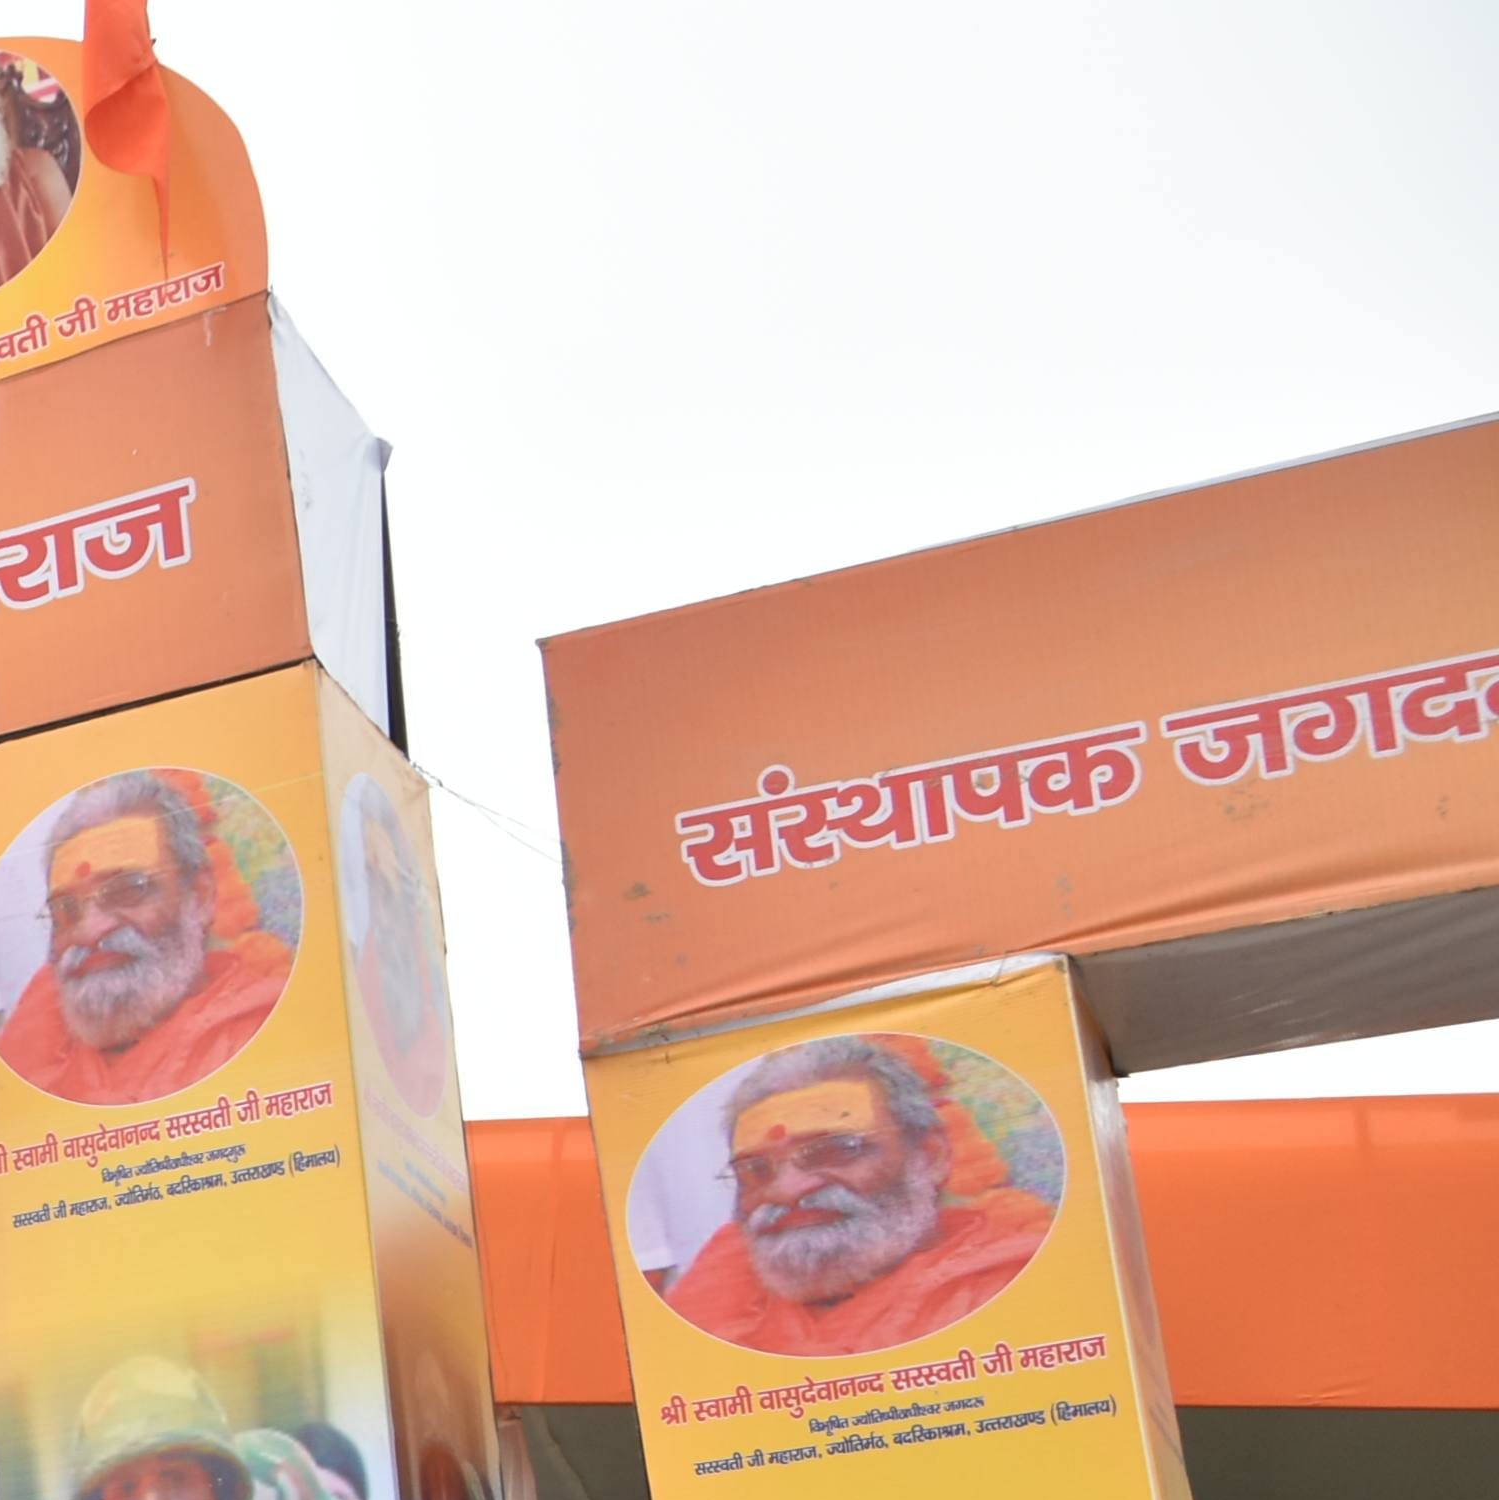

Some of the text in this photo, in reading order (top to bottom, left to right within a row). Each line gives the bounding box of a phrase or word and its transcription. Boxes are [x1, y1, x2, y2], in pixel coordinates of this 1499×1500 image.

[56, 297, 97, 339] जी
[106, 262, 225, 324] महाराज
[677, 648, 1499, 887] संस्थापक जगद
[12, 1134, 58, 1170] स्वामी
[63, 1120, 161, 1170] वासुदेवानन्द
[165, 1096, 232, 1140] सरस्वती
[236, 1090, 260, 1124] जी
[264, 1082, 333, 1118] महाराज
[659, 1334, 1107, 1427] श्री स्वामी वासुदेवानन्द सरस्वती जी महाराज
[746, 1448, 765, 1470] जी
